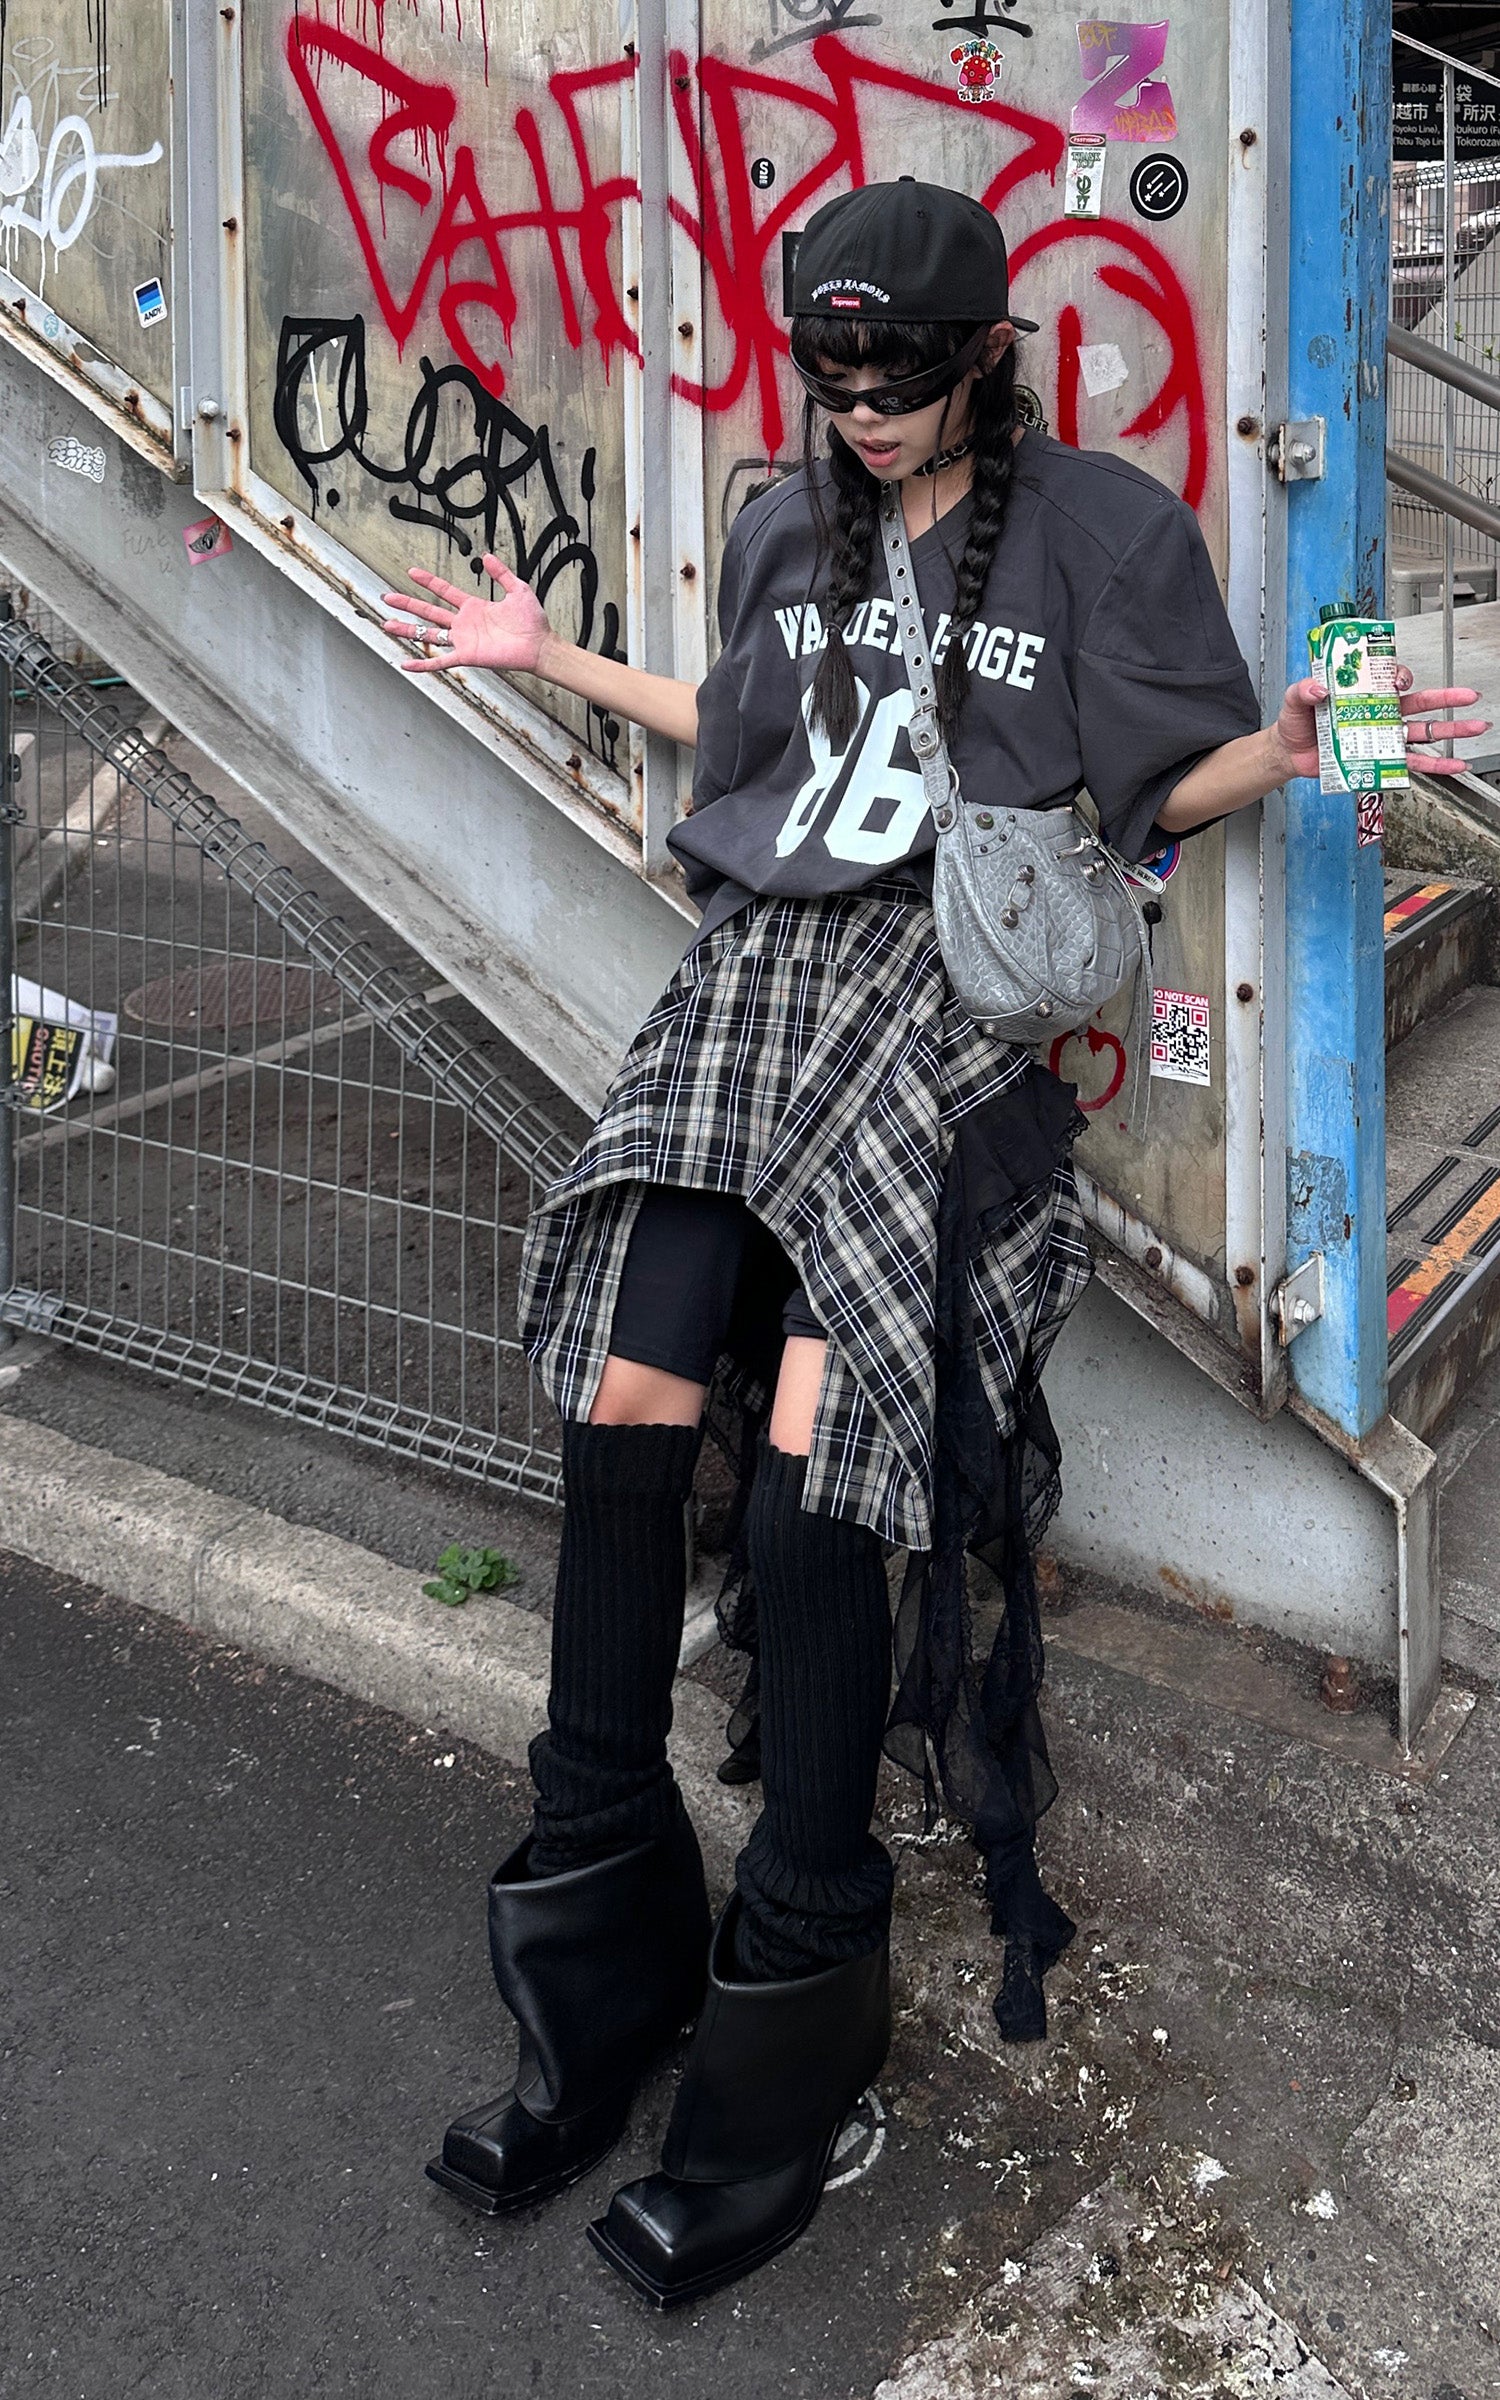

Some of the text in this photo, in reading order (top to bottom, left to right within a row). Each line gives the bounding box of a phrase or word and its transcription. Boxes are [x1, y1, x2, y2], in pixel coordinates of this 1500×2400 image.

[1463, 104, 1496, 121] 所沢
[1432, 137, 1444, 146] Lin
[811, 279, 891, 304] WORLD FAMOUS
[831, 296, 860, 308] Supreme
[1164, 991, 1184, 1002] NOT
[1184, 995, 1209, 1007] SCAN
